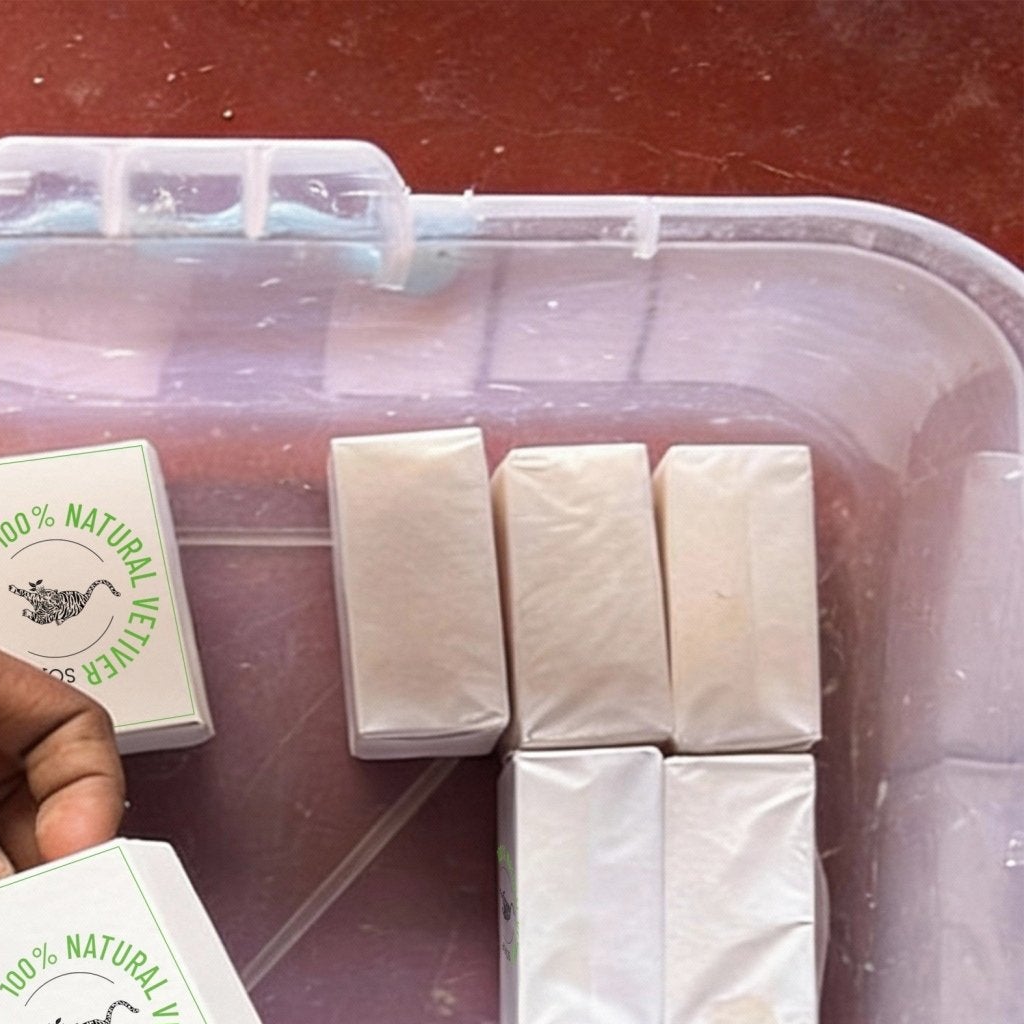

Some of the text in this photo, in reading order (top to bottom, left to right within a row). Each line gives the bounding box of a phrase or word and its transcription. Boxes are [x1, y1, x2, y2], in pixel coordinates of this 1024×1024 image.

[65, 503, 157, 588] NATURAL
[81, 596, 160, 686] VETIVER
[0, 942, 58, 997] 100%
[66, 933, 168, 1000] NATURAL
